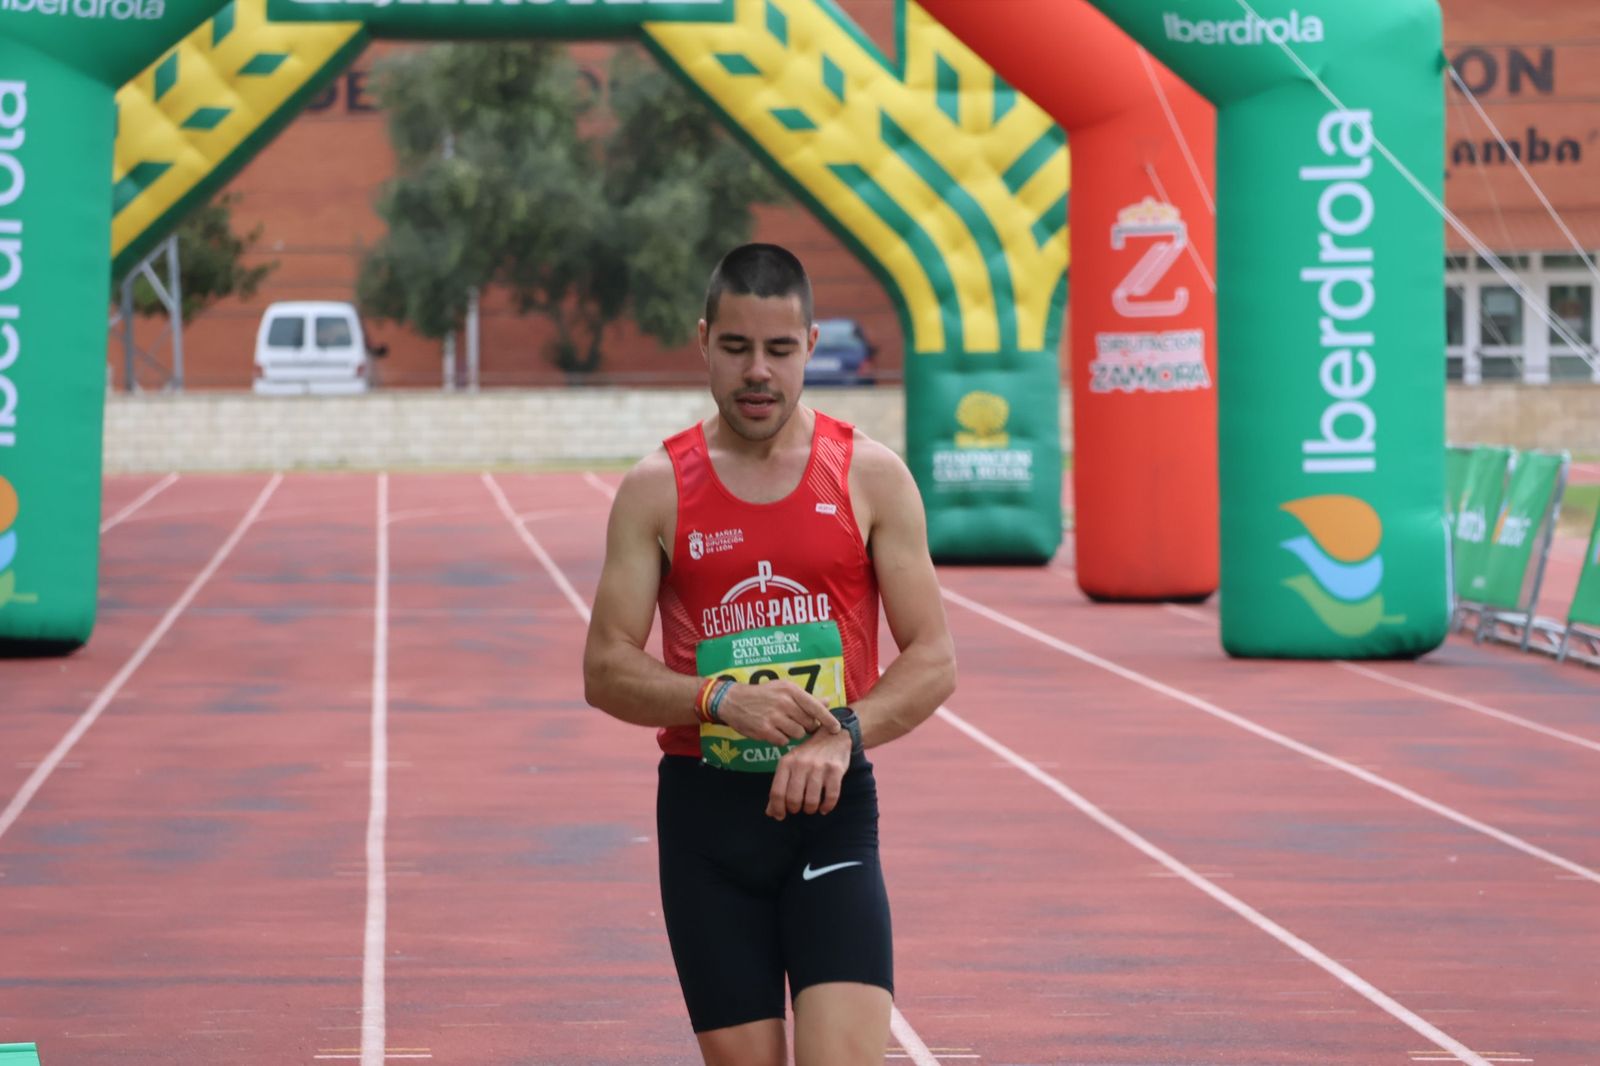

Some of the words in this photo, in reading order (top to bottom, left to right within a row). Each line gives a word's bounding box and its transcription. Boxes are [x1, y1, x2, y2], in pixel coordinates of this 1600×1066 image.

[1163, 9, 1324, 45] Iberdrola
[1300, 108, 1376, 473] Iberdrola
[702, 600, 765, 637] CECINAS
[767, 593, 831, 626] PABLO
[733, 647, 760, 658] CAJA
[763, 643, 801, 656] RURAL
[742, 747, 781, 762] CAJA
